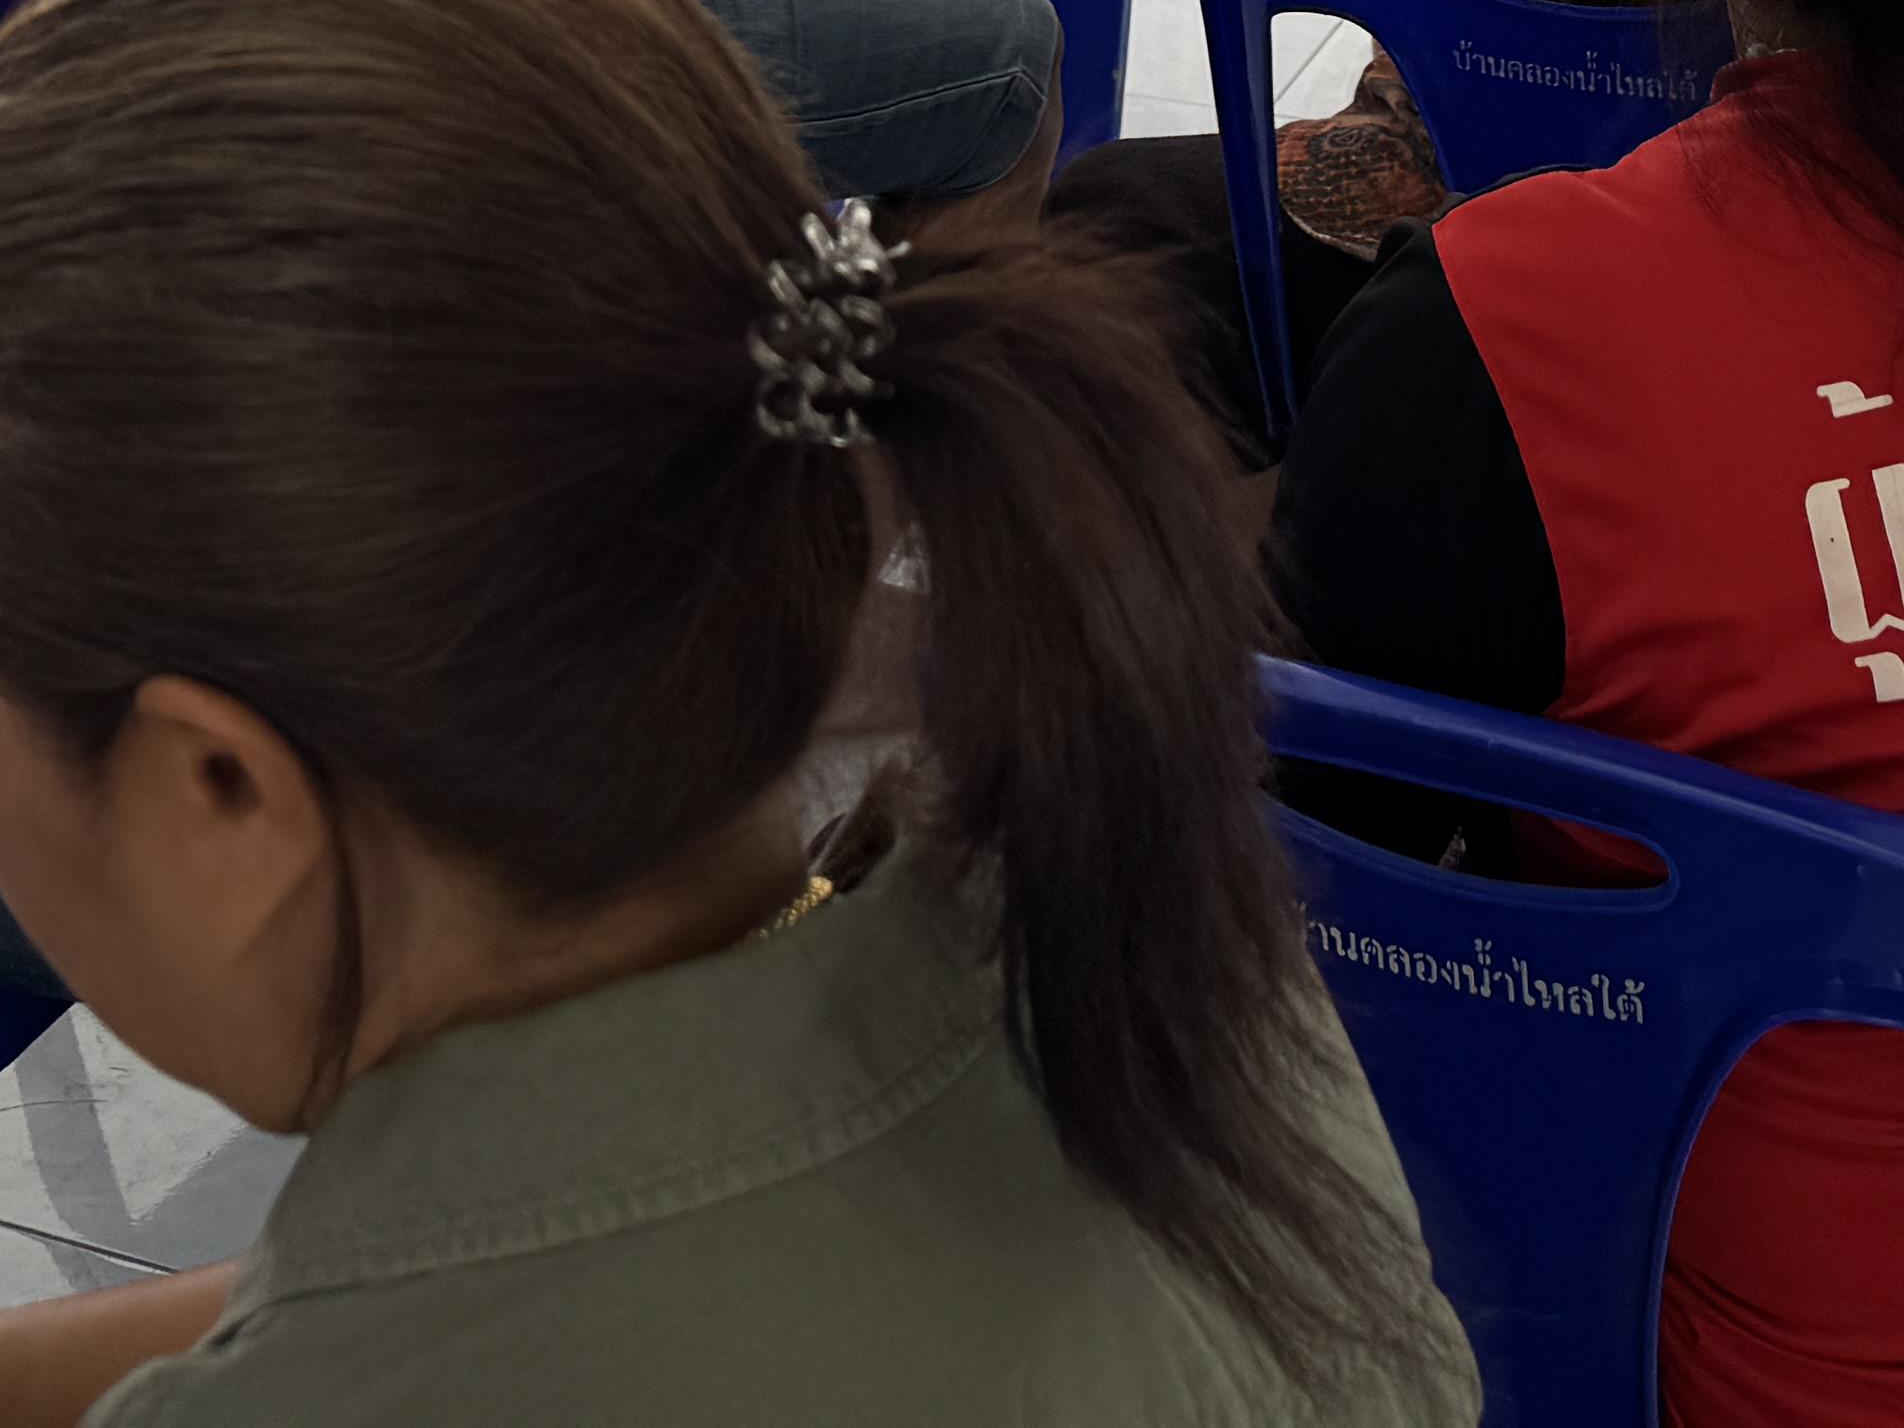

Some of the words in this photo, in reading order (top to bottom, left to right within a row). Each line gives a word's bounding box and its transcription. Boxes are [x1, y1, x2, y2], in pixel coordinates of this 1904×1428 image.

[1306, 922, 1646, 1025] านคลองน้ำไหลใต้
